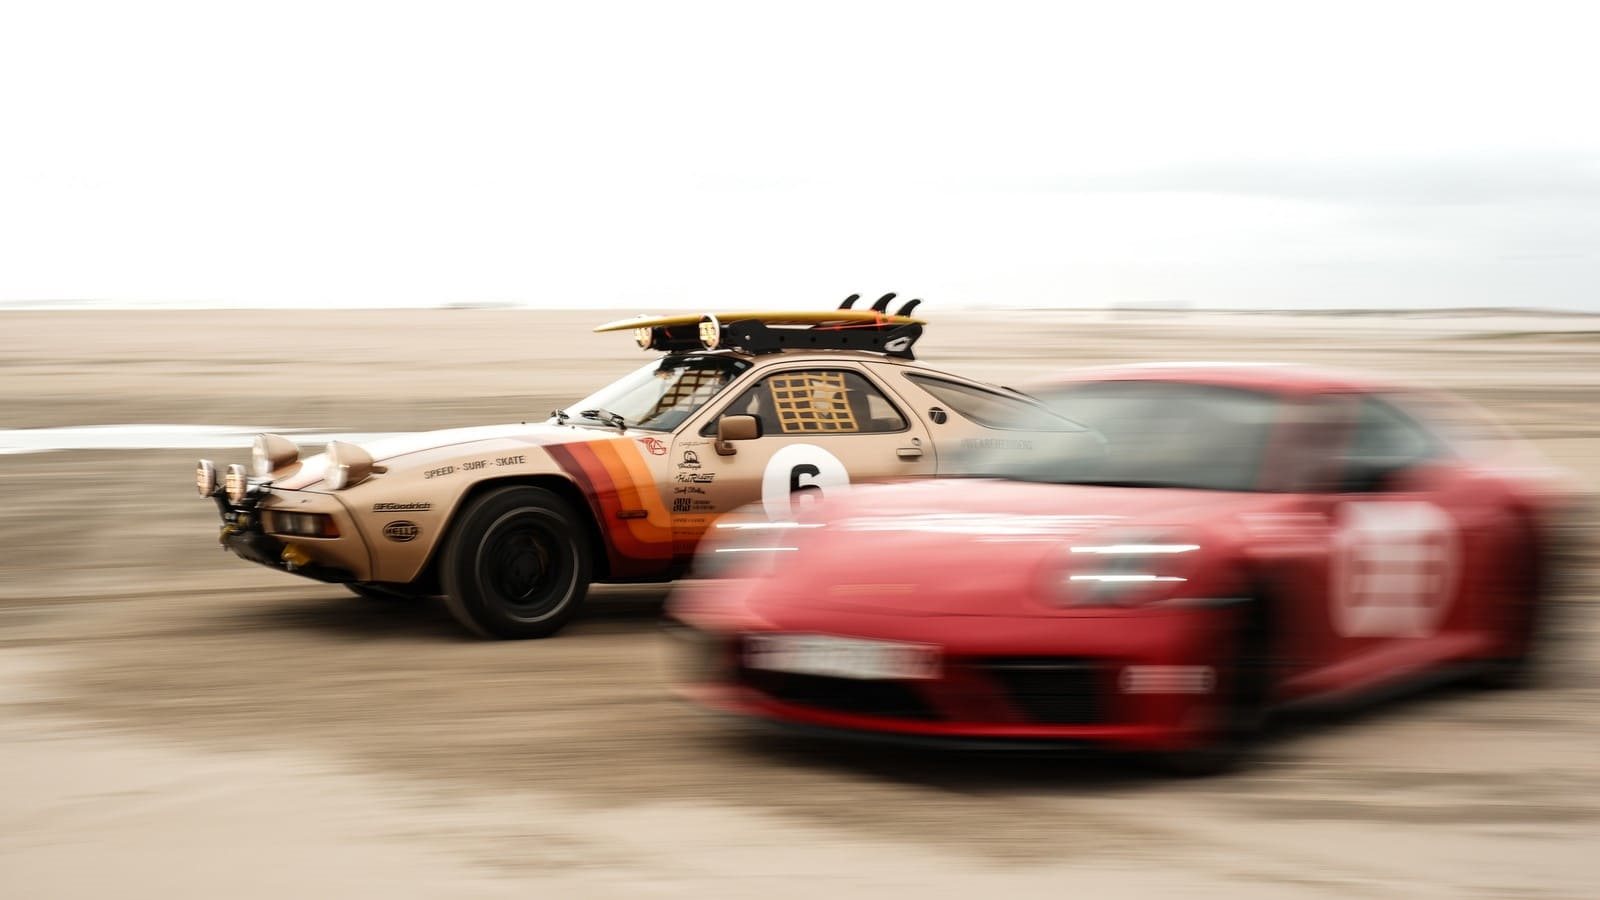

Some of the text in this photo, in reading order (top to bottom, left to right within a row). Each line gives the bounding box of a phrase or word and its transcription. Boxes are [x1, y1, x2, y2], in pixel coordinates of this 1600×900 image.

[424, 466, 454, 479] SPEED
[462, 460, 487, 471] SURF
[496, 455, 525, 466] SKATE
[790, 464, 824, 512] 6
[373, 502, 431, 510] BFGoodrich
